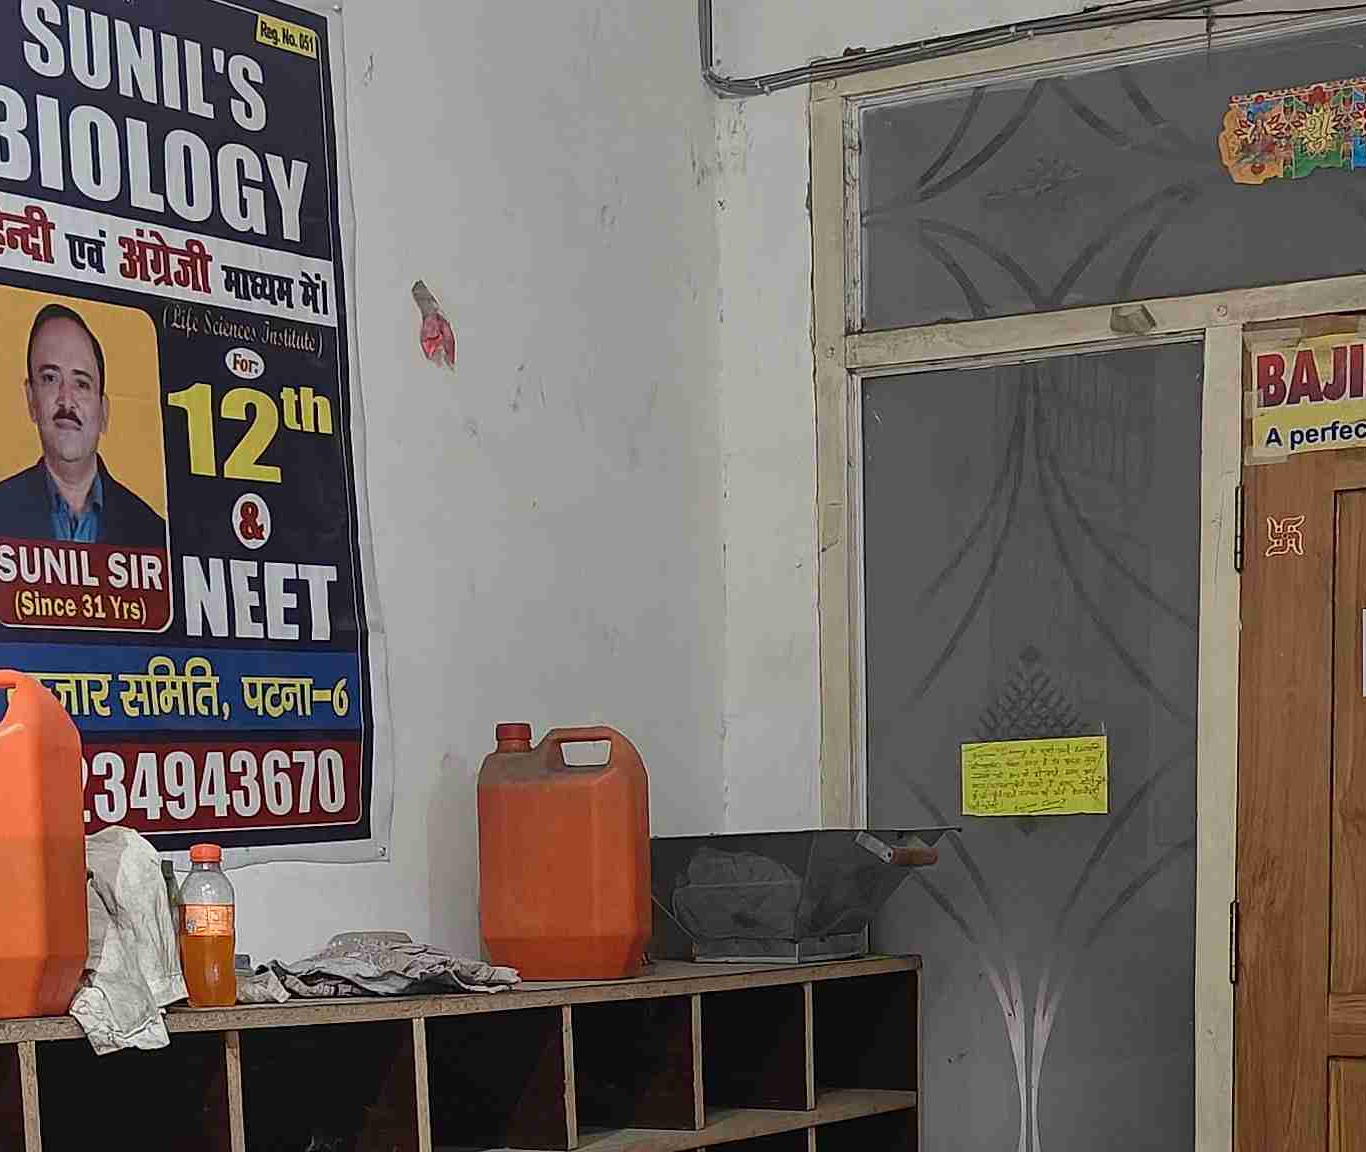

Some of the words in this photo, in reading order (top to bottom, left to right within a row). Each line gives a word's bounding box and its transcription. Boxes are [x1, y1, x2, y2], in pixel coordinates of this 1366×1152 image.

[260, 20, 280, 45] Reg.
[21, 0, 267, 131] SUNIL'S
[65, 230, 107, 274] एवं
[118, 228, 212, 295] अंग्रेजी
[221, 264, 294, 309] माध्यम
[204, 309, 257, 342] Sciences
[168, 382, 333, 483] 12th
[1265, 426, 1283, 447] A
[239, 501, 265, 542] &
[107, 551, 164, 591] SIR
[14, 590, 77, 621] (Since
[81, 596, 107, 619] 31
[110, 596, 148, 624] Yrs)
[182, 555, 337, 642] NEET
